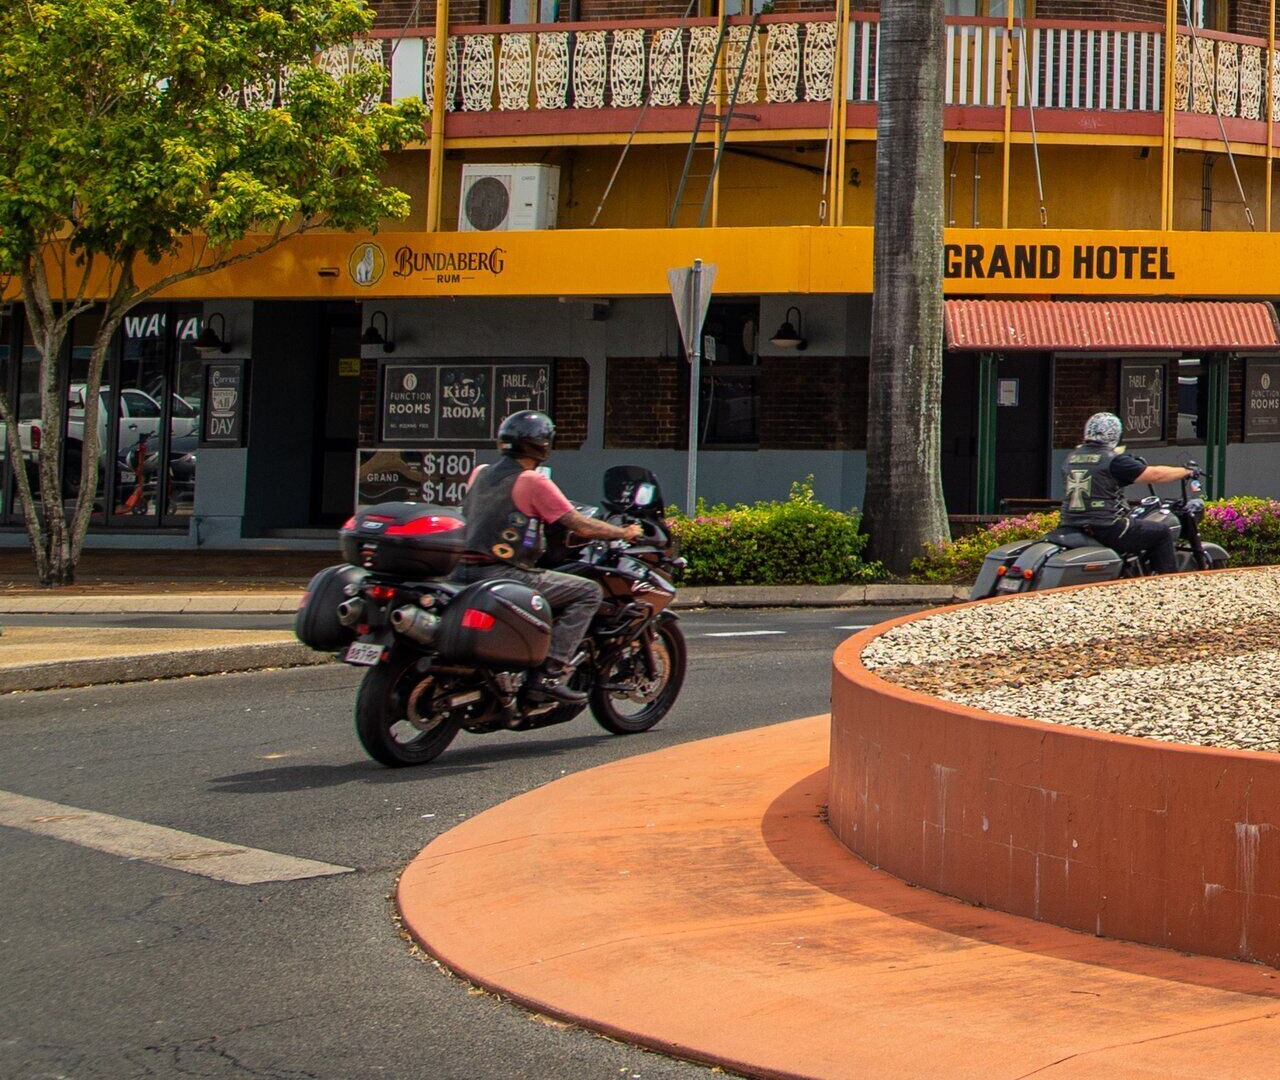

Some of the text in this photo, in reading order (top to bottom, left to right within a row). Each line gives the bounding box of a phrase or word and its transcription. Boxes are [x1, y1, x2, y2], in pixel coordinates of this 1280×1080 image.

[393, 245, 504, 278] BUNDABERG
[943, 244, 1176, 280] GRAND HOTEL
[437, 274, 460, 283] RUM
[502, 374, 527, 387] TABLE
[390, 392, 432, 401] FUNCTION
[389, 404, 431, 415] ROOMS
[1251, 399, 1280, 409] ROOMS
[442, 407, 486, 419] ROOM
[211, 418, 234, 435] DAY
[423, 452, 471, 477] $180
[367, 473, 399, 482] GRAND
